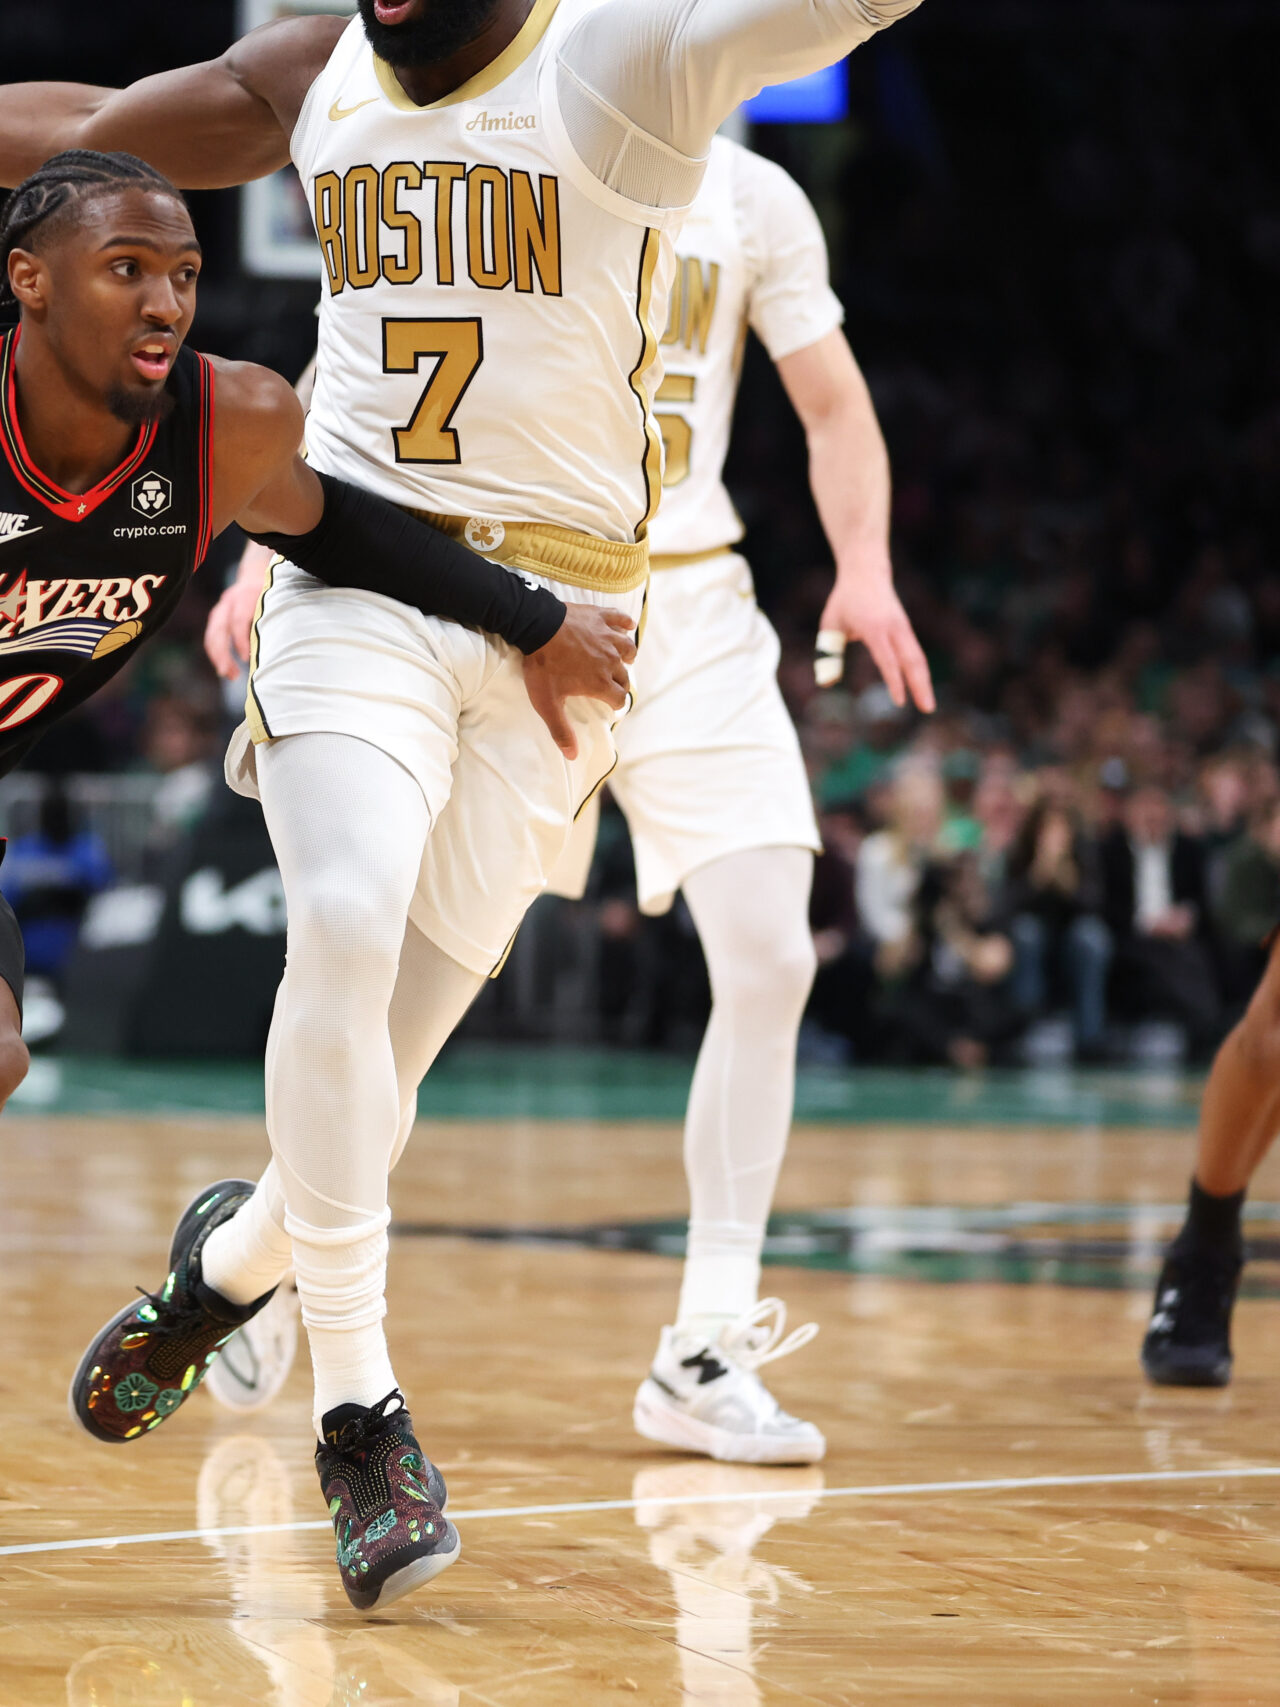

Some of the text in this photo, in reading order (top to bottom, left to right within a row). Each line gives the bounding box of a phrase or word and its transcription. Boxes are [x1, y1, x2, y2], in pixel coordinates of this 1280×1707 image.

[465, 111, 536, 131] Amica
[314, 160, 563, 297] BOSTON
[382, 317, 484, 464] 7
[113, 524, 187, 539] crypto.com
